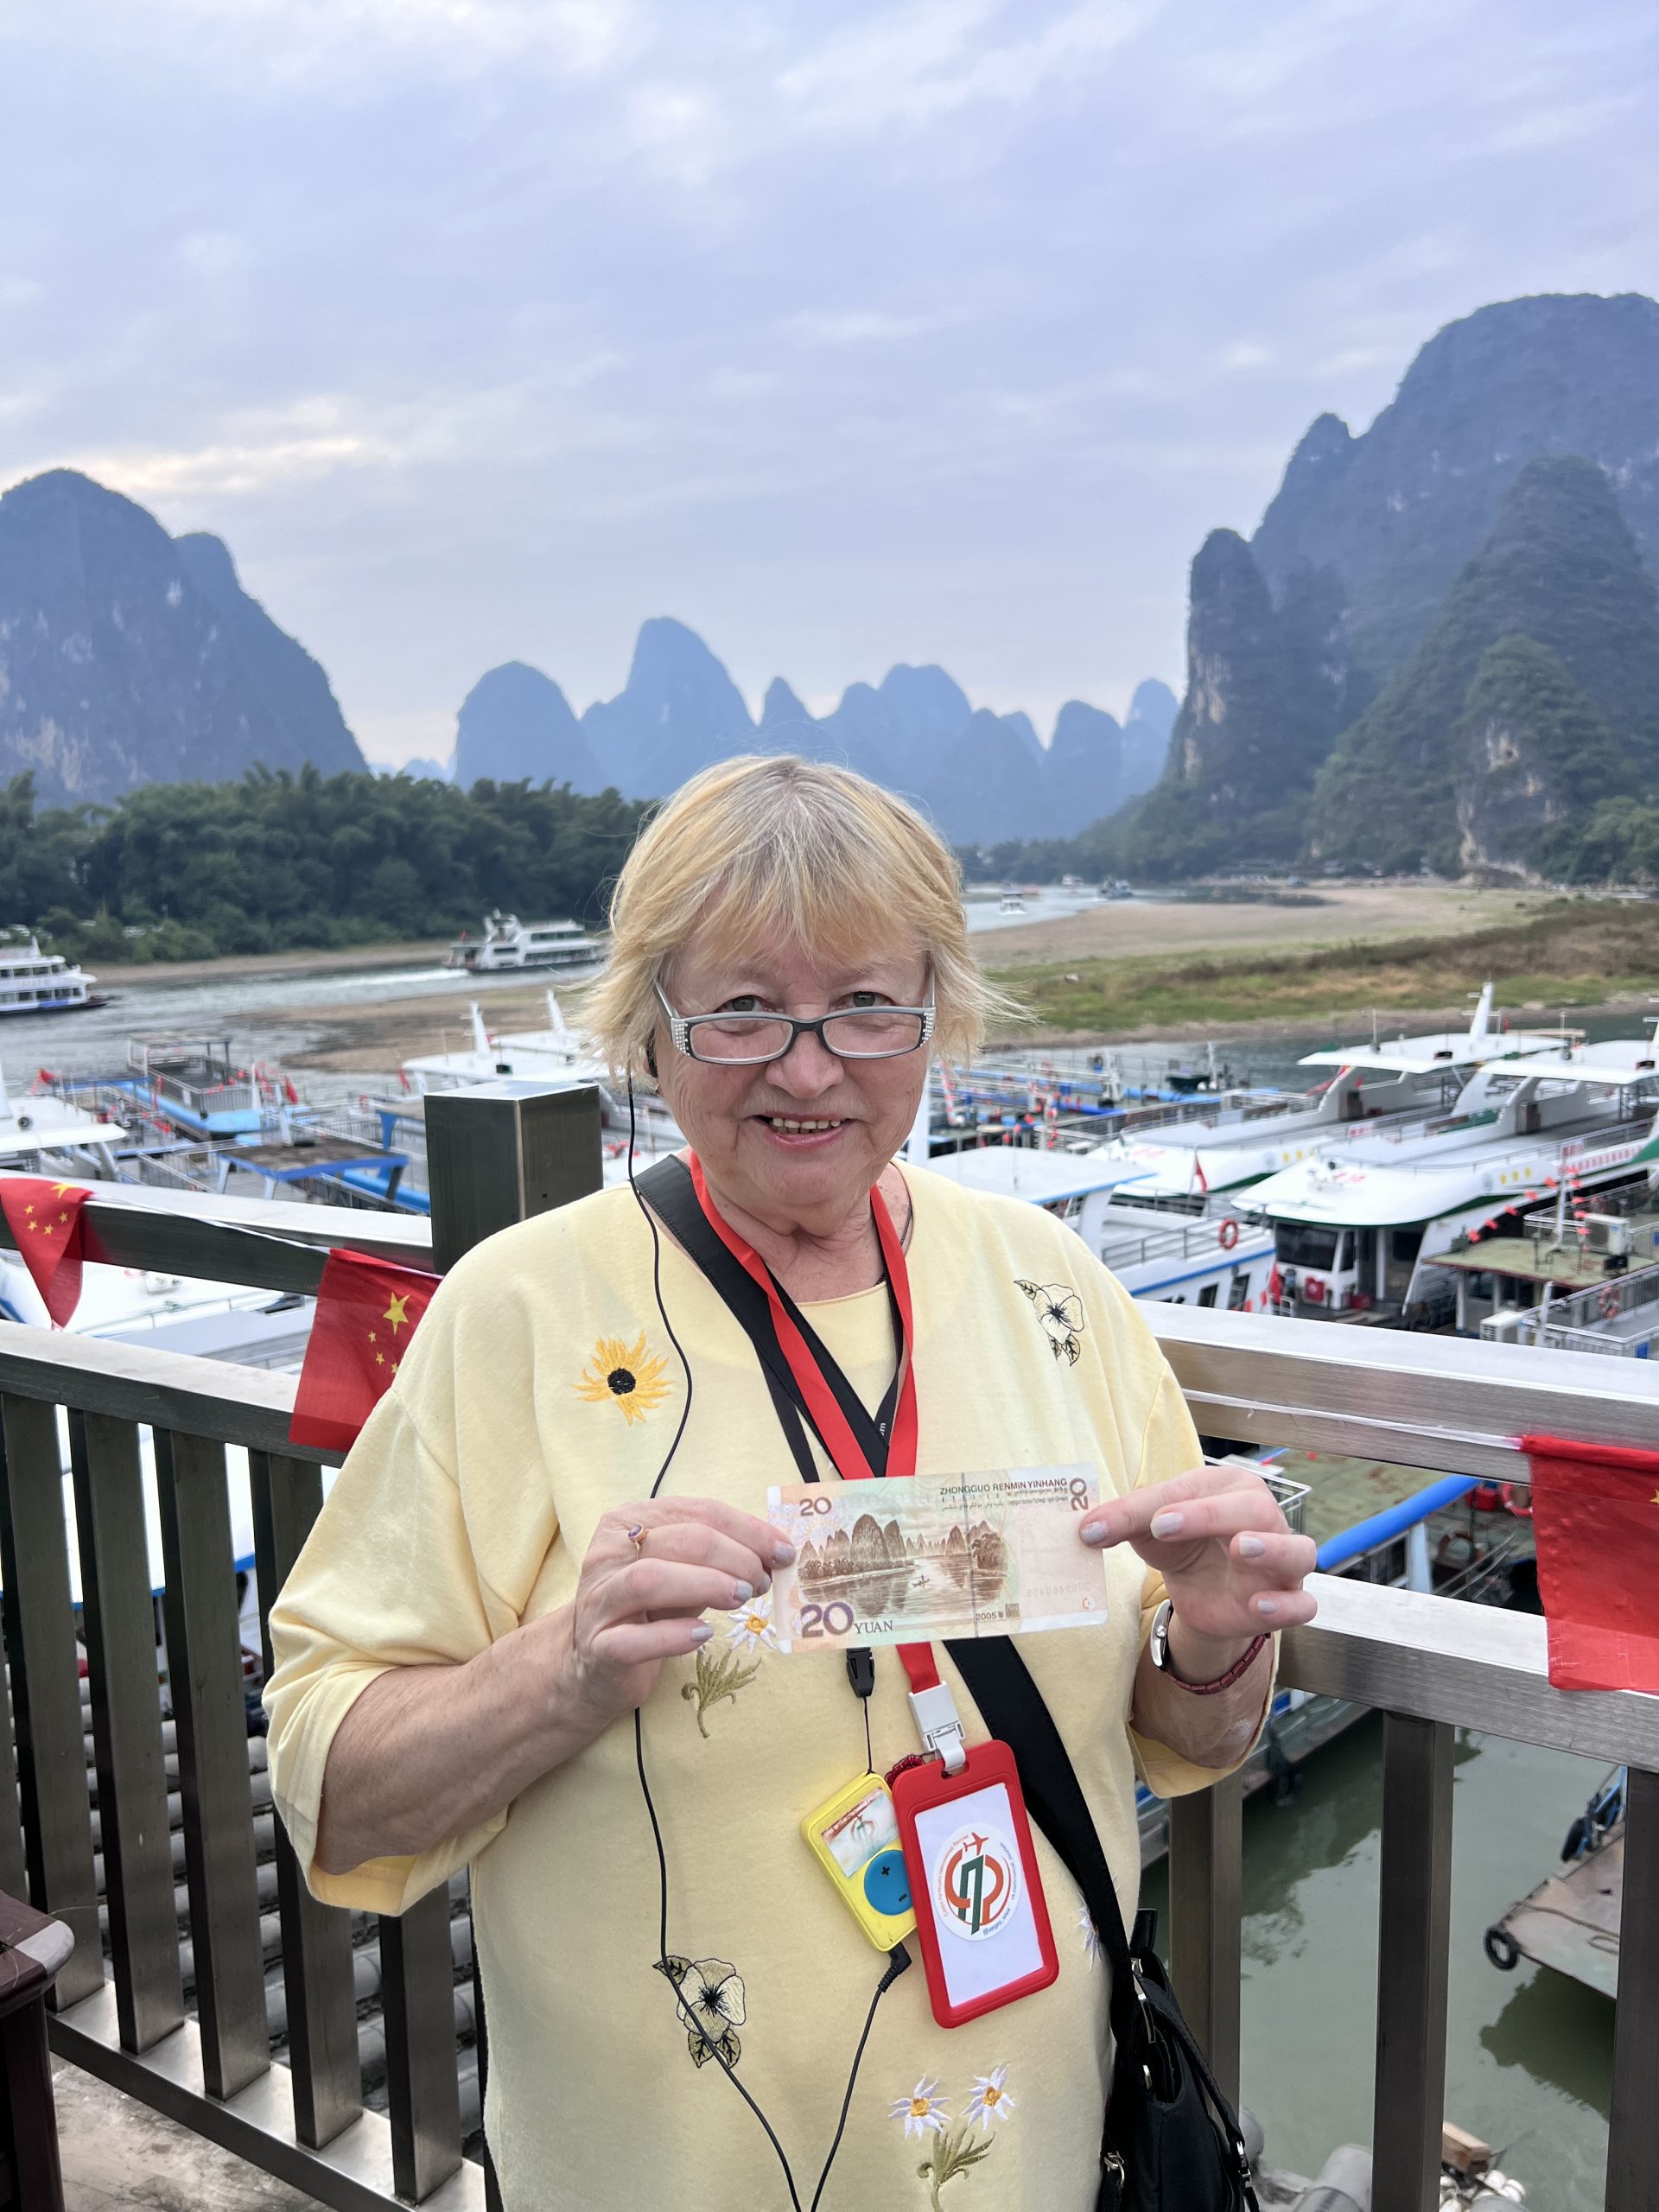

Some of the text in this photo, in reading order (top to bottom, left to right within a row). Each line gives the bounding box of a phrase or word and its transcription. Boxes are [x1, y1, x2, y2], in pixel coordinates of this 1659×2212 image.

[939, 1484, 991, 1496] ZHONGGUO
[993, 1480, 1027, 1492] RENMIN
[1027, 1478, 1068, 1490] YINHANG
[1069, 1478, 1090, 1511] 20
[799, 1497, 832, 1517] 20
[800, 1601, 854, 1639] 20
[854, 1620, 893, 1634] YUAN
